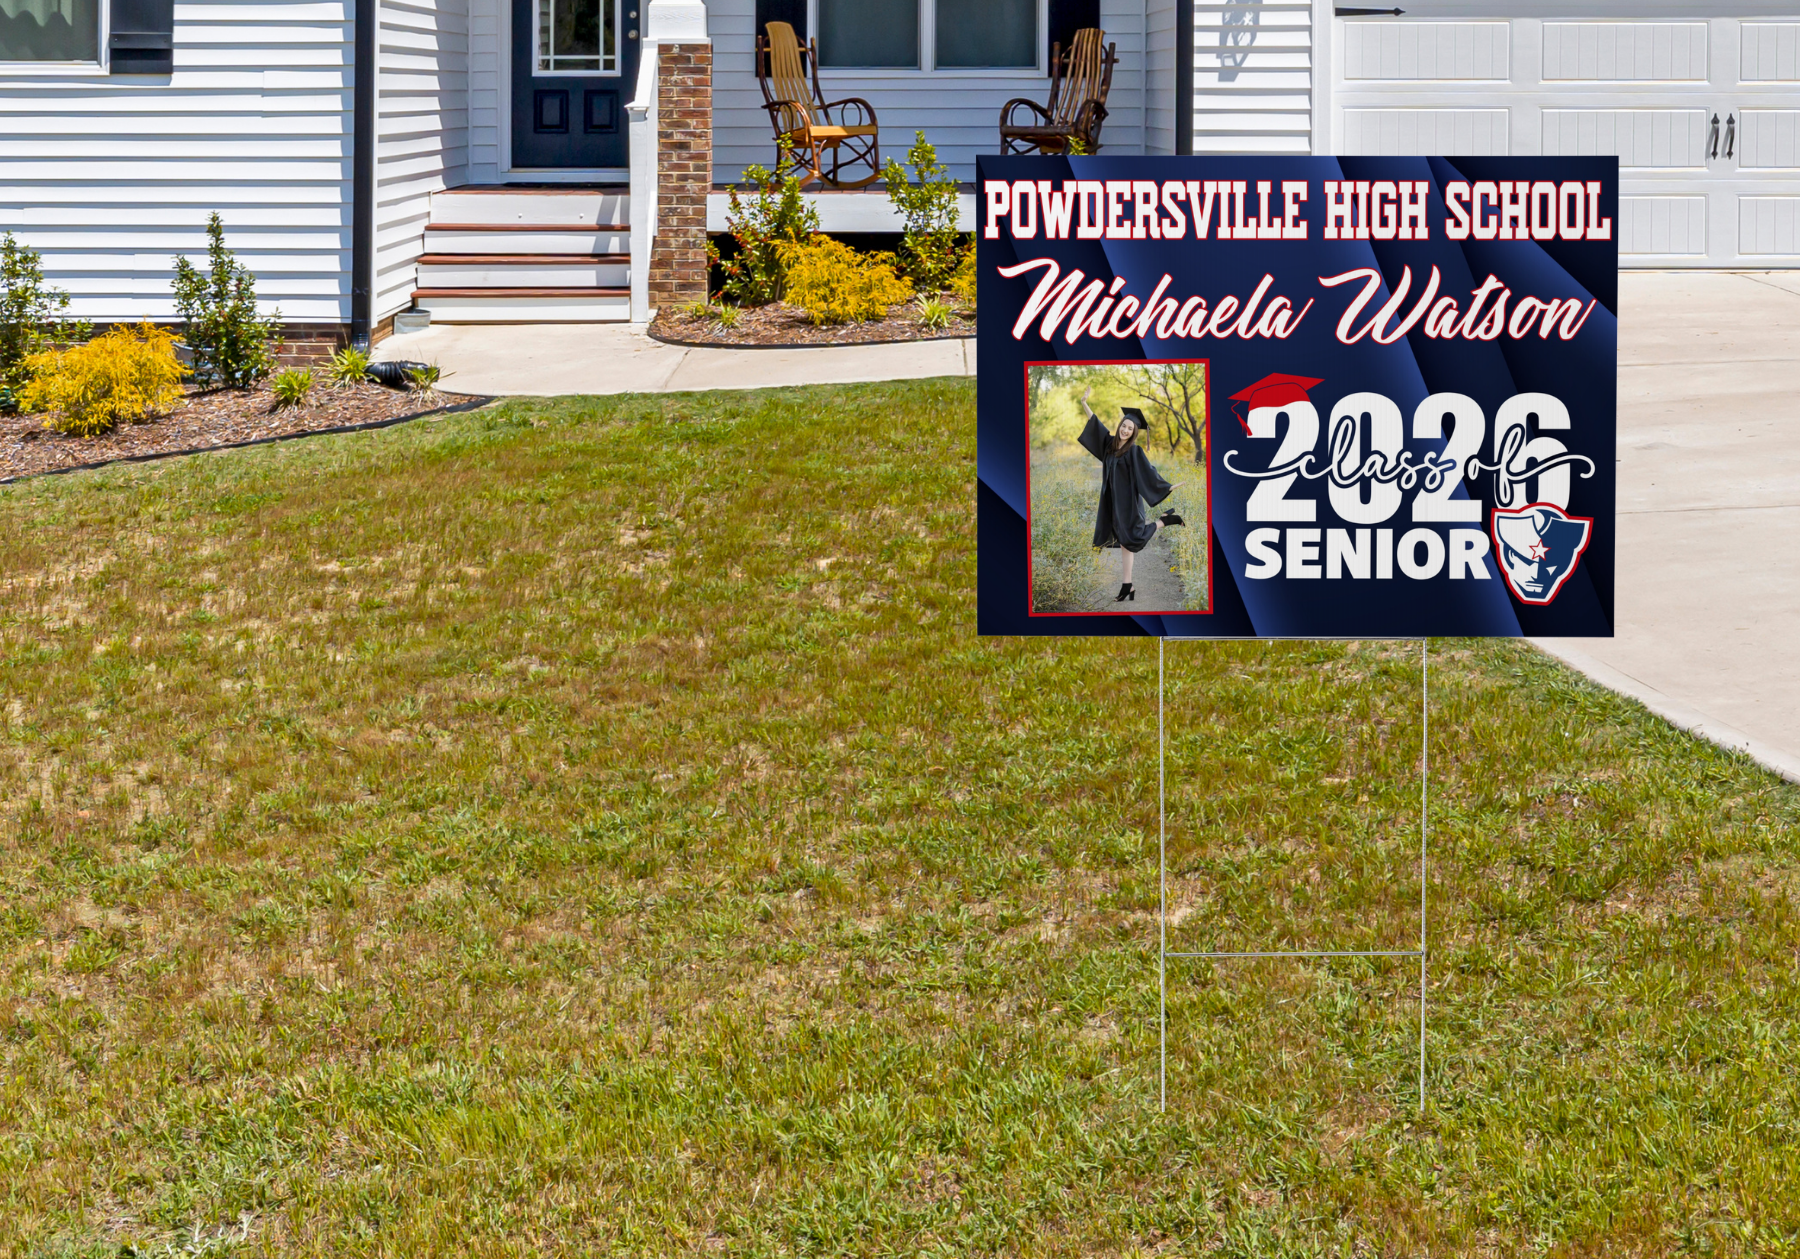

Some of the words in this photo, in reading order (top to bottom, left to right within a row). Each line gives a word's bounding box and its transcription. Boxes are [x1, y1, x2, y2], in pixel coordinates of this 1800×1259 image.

[984, 180, 1308, 240] POWDERSVILLE
[1323, 180, 1430, 240] HIGH
[1445, 180, 1612, 240] SCHOOL
[997, 257, 1314, 345] Michaela
[1318, 263, 1597, 345] Watson
[1223, 414, 1457, 491] class
[1468, 422, 1595, 507] of
[1246, 392, 1571, 524] 2026
[1244, 527, 1492, 580] SENIOR
